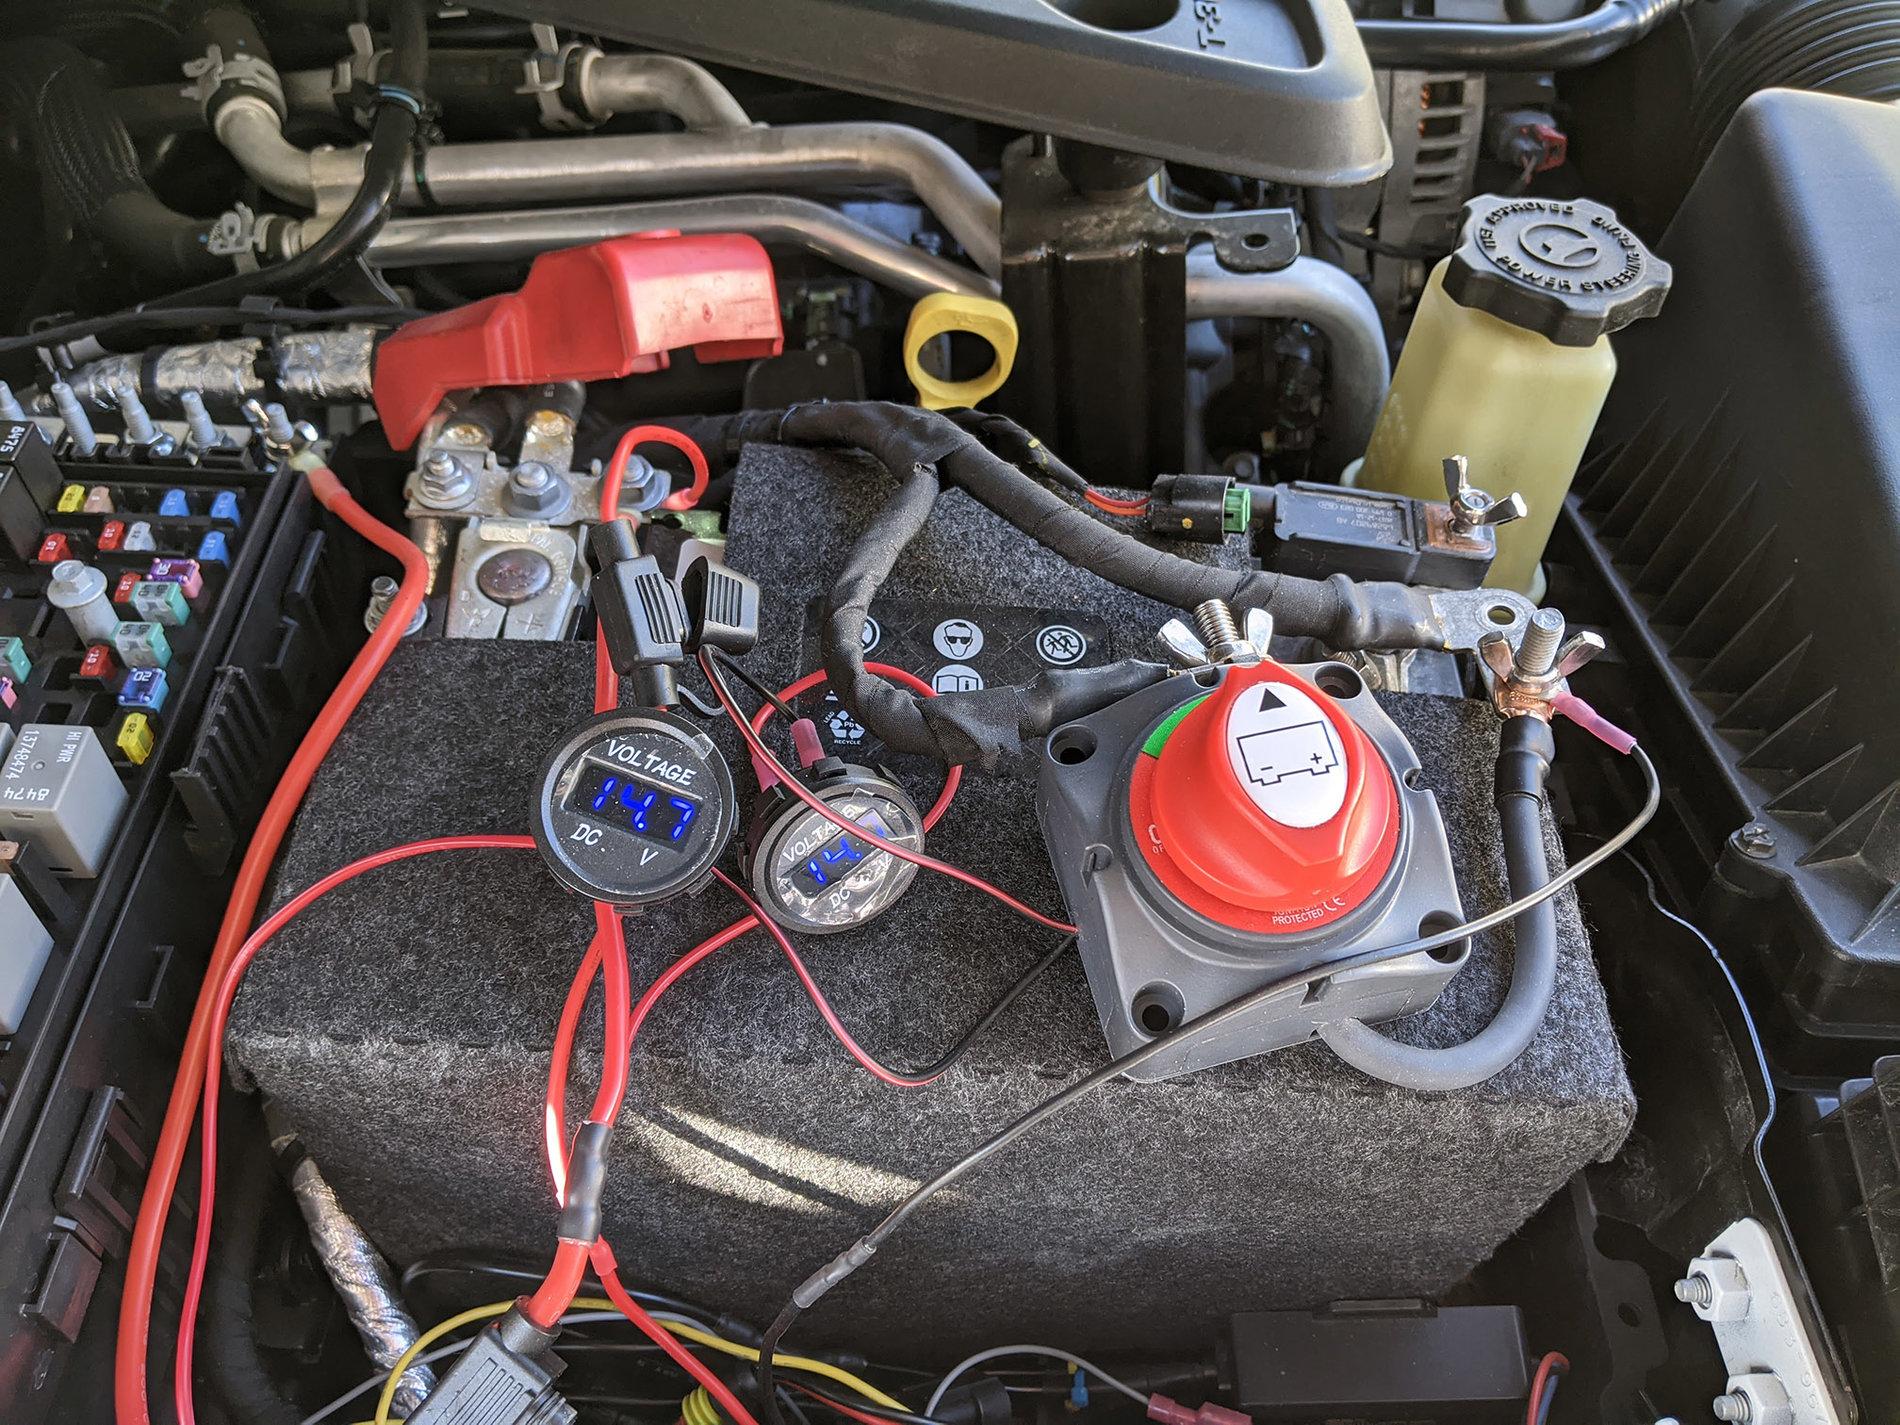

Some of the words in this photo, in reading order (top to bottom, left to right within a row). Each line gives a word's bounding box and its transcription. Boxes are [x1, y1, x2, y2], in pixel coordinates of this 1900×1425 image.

[1485, 202, 1573, 225] APPROVED
[1496, 255, 1572, 290] POWER
[1580, 250, 1641, 291] STEERING
[133, 671, 152, 682] 20
[66, 731, 82, 741] HI
[5, 730, 40, 780] 13748474
[56, 743, 77, 763] PWR
[607, 739, 697, 786] VOLTAGE
[3, 786, 50, 801] 8474
[592, 777, 696, 841] 14.7
[570, 822, 603, 848] DC
[639, 847, 659, 866] V
[829, 887, 851, 909] DC
[1271, 908, 1325, 926] PROTECTED
